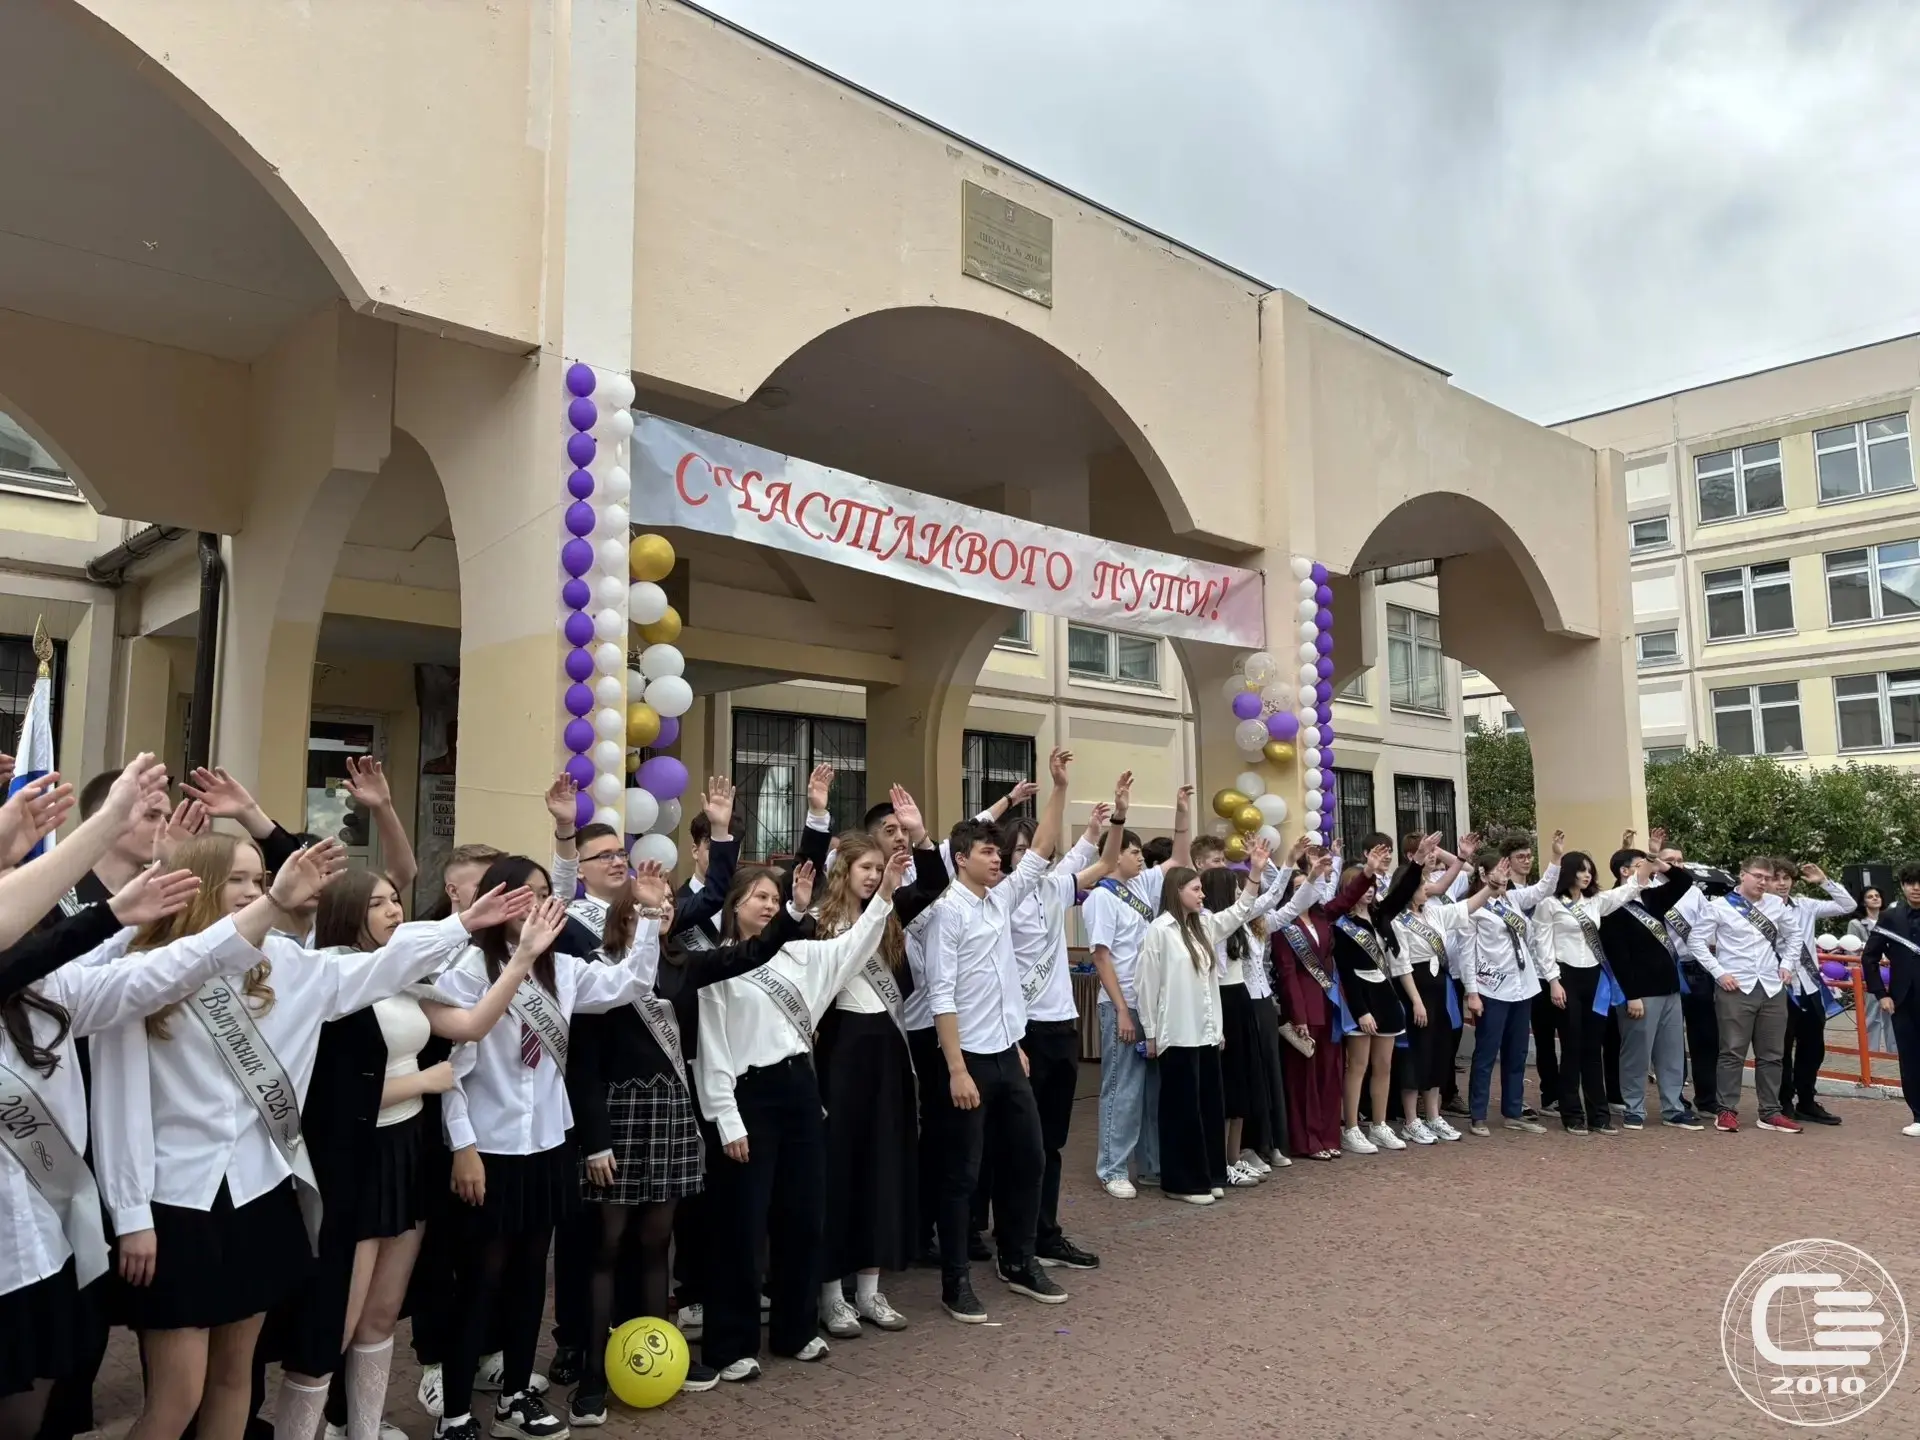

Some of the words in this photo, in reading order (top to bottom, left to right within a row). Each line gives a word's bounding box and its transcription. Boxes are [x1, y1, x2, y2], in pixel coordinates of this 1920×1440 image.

[979, 231, 1012, 253] ШКОЛА
[675, 452, 1073, 592] СЧАСТЛИВОГО
[1092, 560, 1231, 621] ПУТИ!
[752, 966, 803, 1017] Выпускник
[199, 986, 266, 1076] Выпускник
[256, 1079, 296, 1121] 2026
[0, 1095, 52, 1140] 2026
